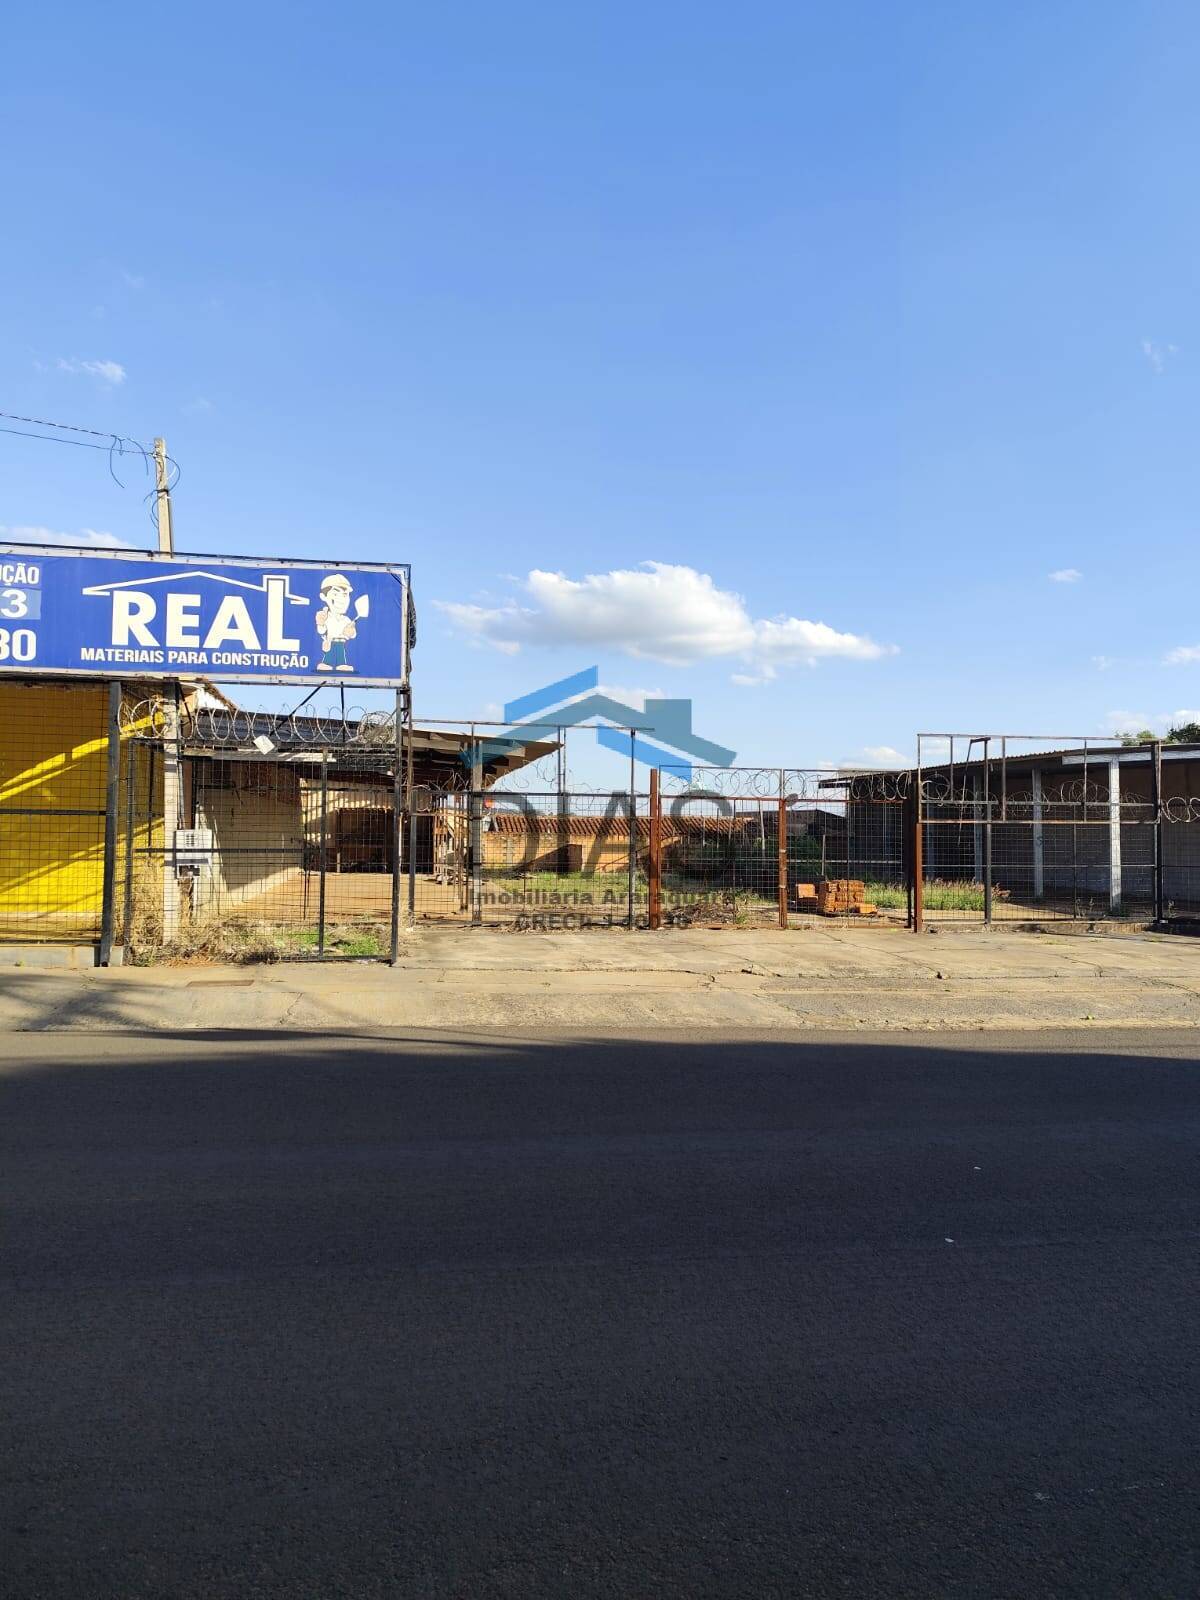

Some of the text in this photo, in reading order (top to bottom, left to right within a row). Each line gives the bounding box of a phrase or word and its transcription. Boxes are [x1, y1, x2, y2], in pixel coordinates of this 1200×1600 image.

[0, 562, 40, 586] ÇÃO
[111, 578, 300, 651] REAL
[80, 647, 309, 669] MATERIAIS PARA CONSTRUÇÃO
